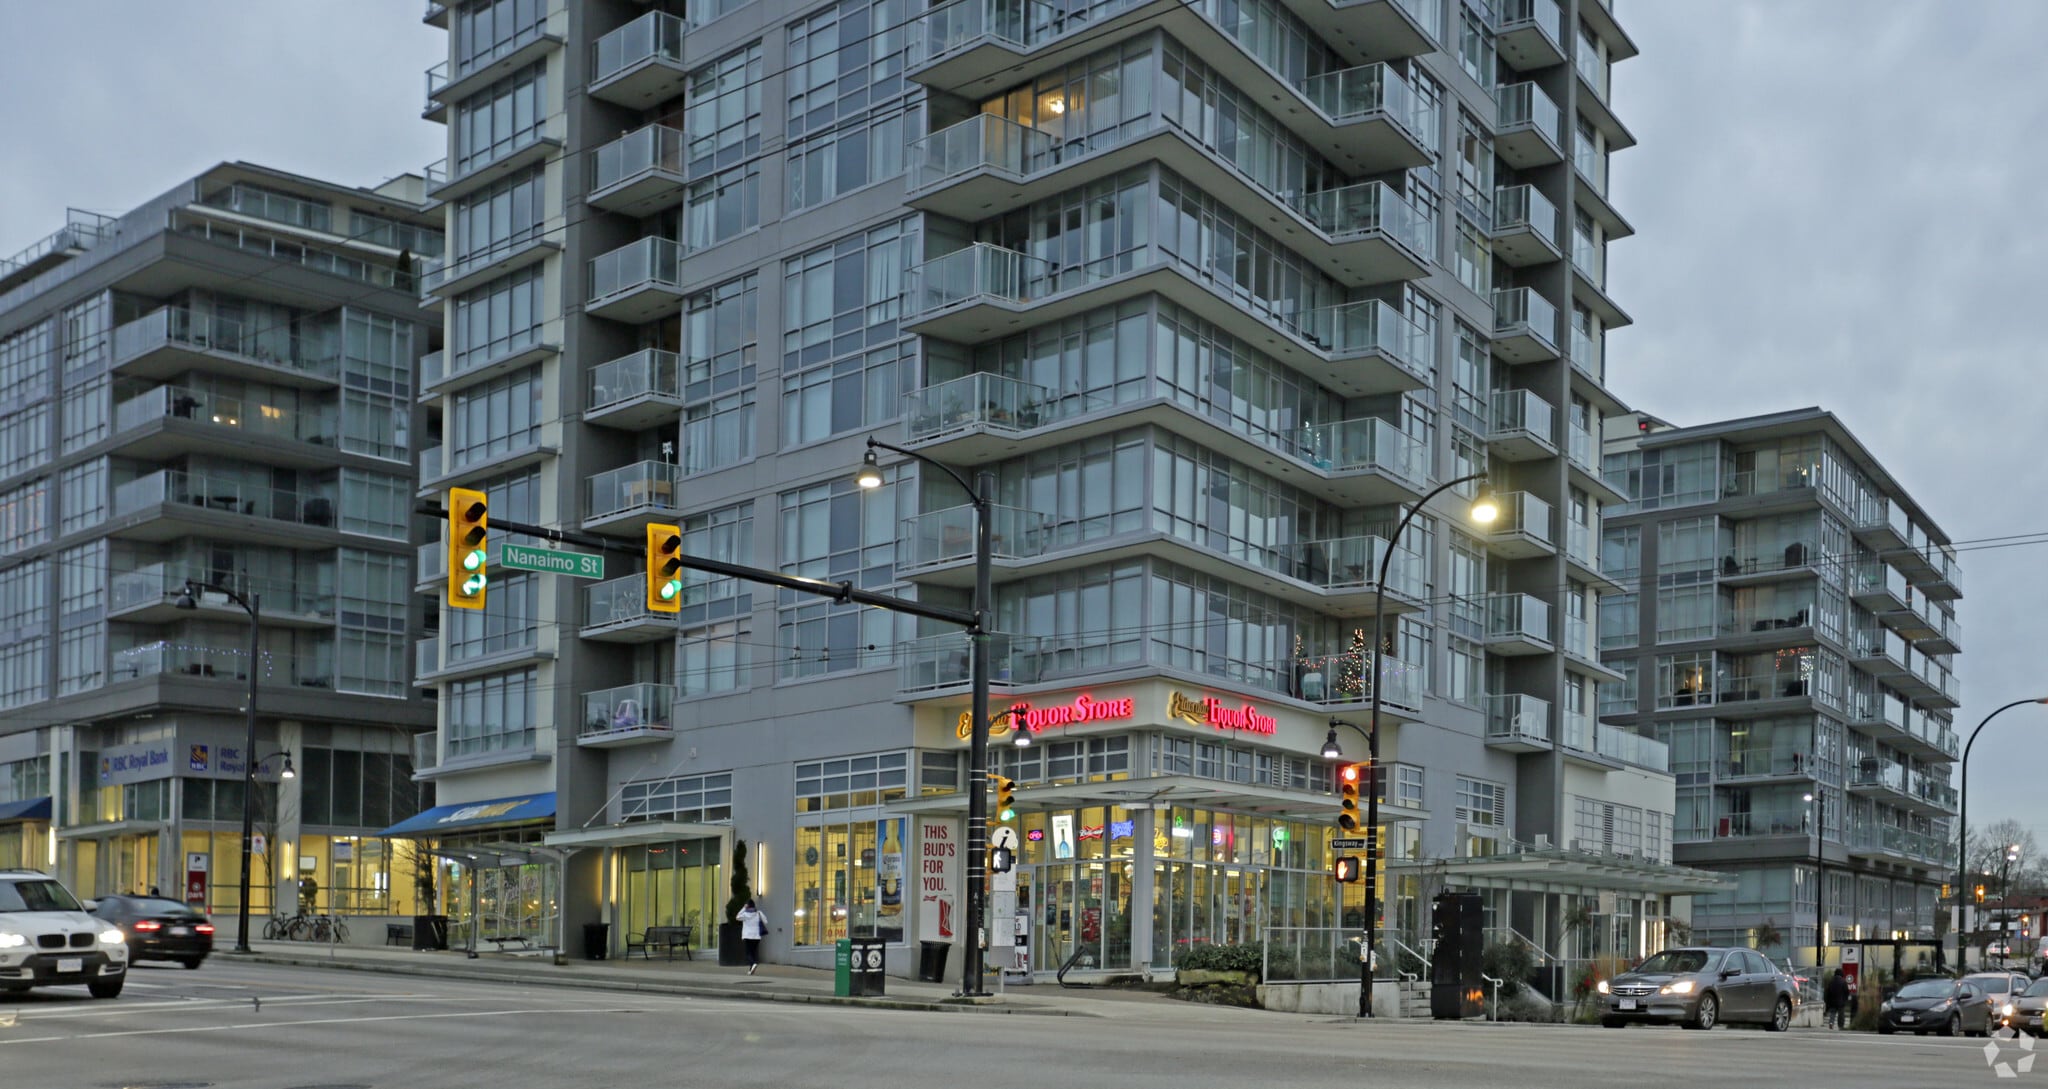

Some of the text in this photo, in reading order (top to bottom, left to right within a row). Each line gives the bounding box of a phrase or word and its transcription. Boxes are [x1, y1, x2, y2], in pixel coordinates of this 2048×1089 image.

[507, 547, 598, 574] Nanaimo St
[1074, 695, 1131, 721] STORE
[1245, 705, 1277, 734] STORE
[113, 747, 168, 772] RBC Royal Bank
[220, 747, 240, 760] RBC
[220, 761, 246, 774] Royal
[924, 825, 948, 839] THIS
[924, 842, 955, 857] BUD'S
[1333, 840, 1358, 848] Kingsway
[923, 859, 944, 874] FOR
[923, 877, 947, 892] YOU.
